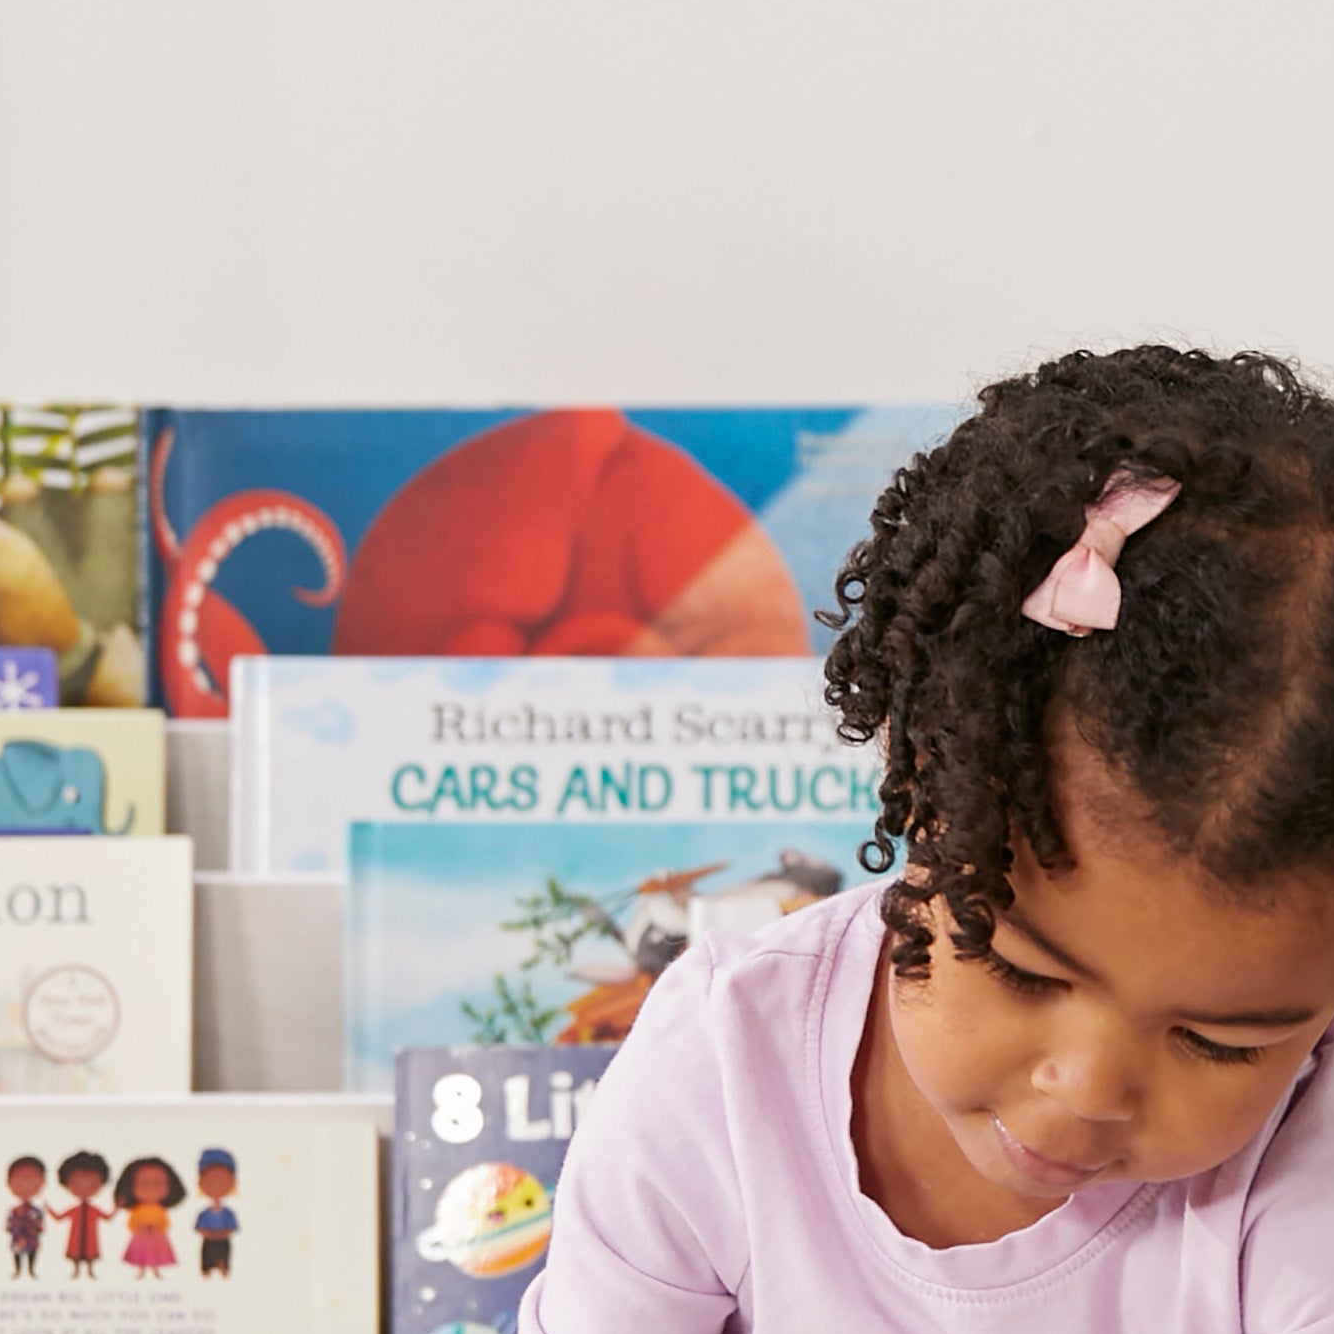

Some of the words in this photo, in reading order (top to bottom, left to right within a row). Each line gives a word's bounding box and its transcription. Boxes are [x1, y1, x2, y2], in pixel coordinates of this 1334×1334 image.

[432, 702, 655, 745] Richard
[391, 761, 539, 817] CARS
[555, 757, 674, 818] AND
[431, 1072, 485, 1145] 8
